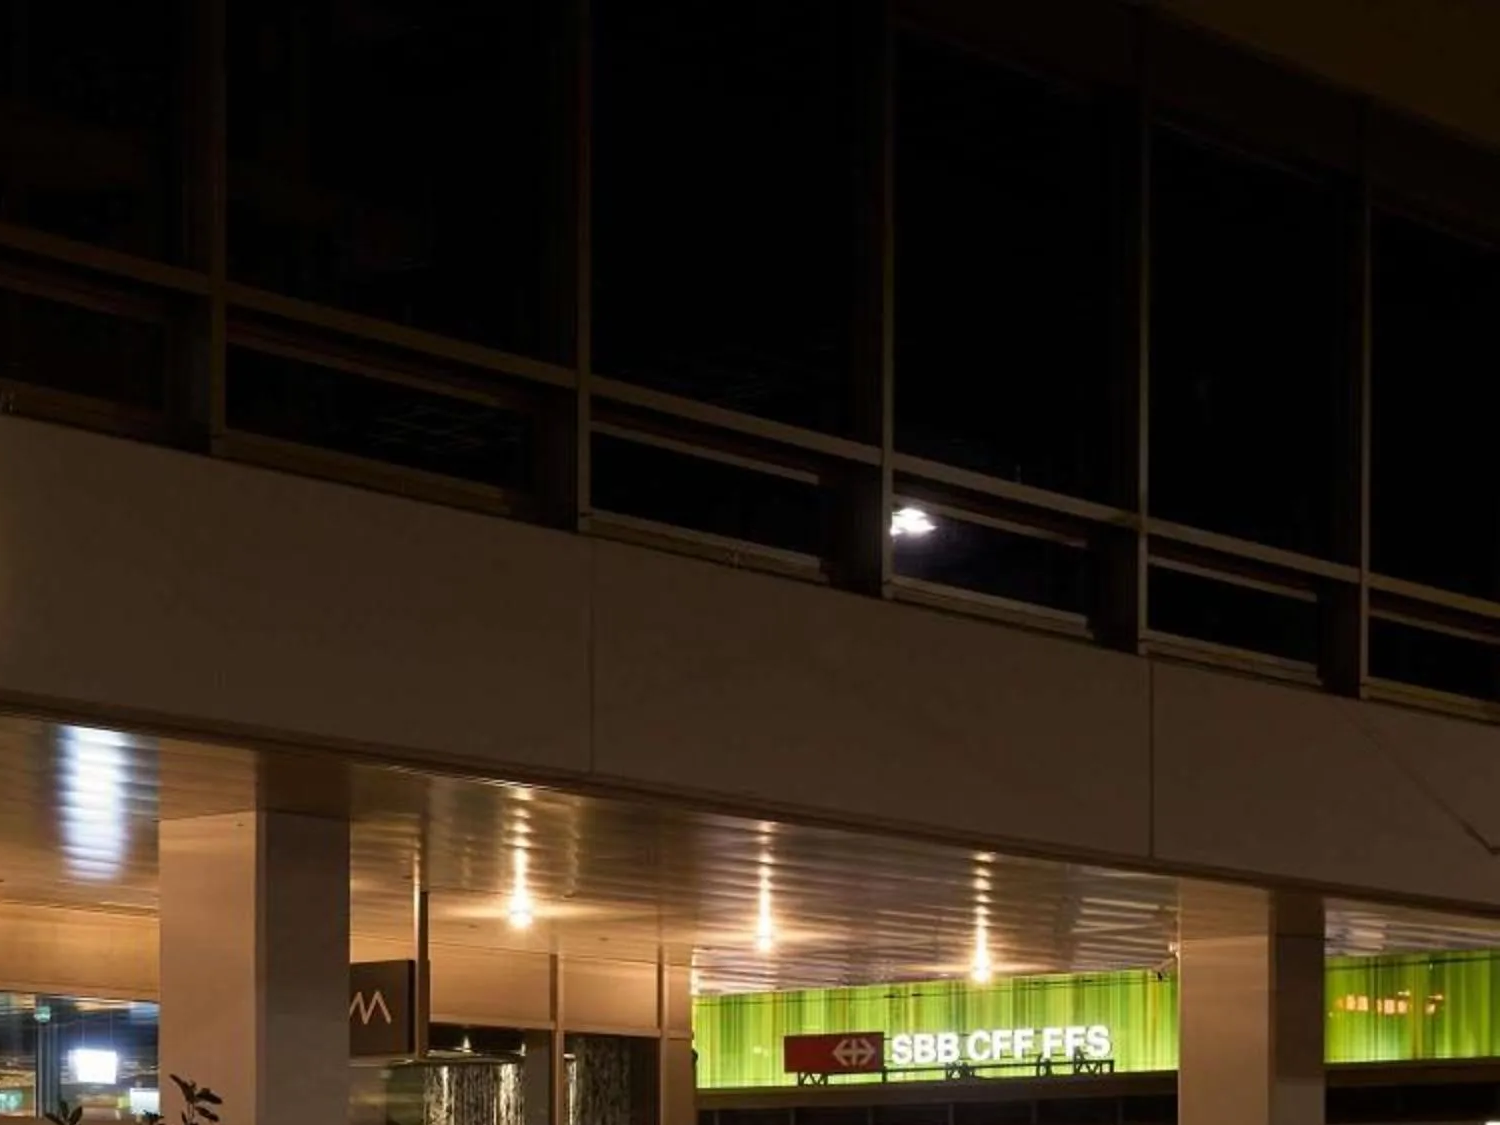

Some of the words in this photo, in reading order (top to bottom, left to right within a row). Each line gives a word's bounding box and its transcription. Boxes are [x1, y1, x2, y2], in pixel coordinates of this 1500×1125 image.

[891, 1031, 960, 1064] SBB
[967, 1027, 1036, 1062] CFF
[1041, 1024, 1111, 1060] FFS
